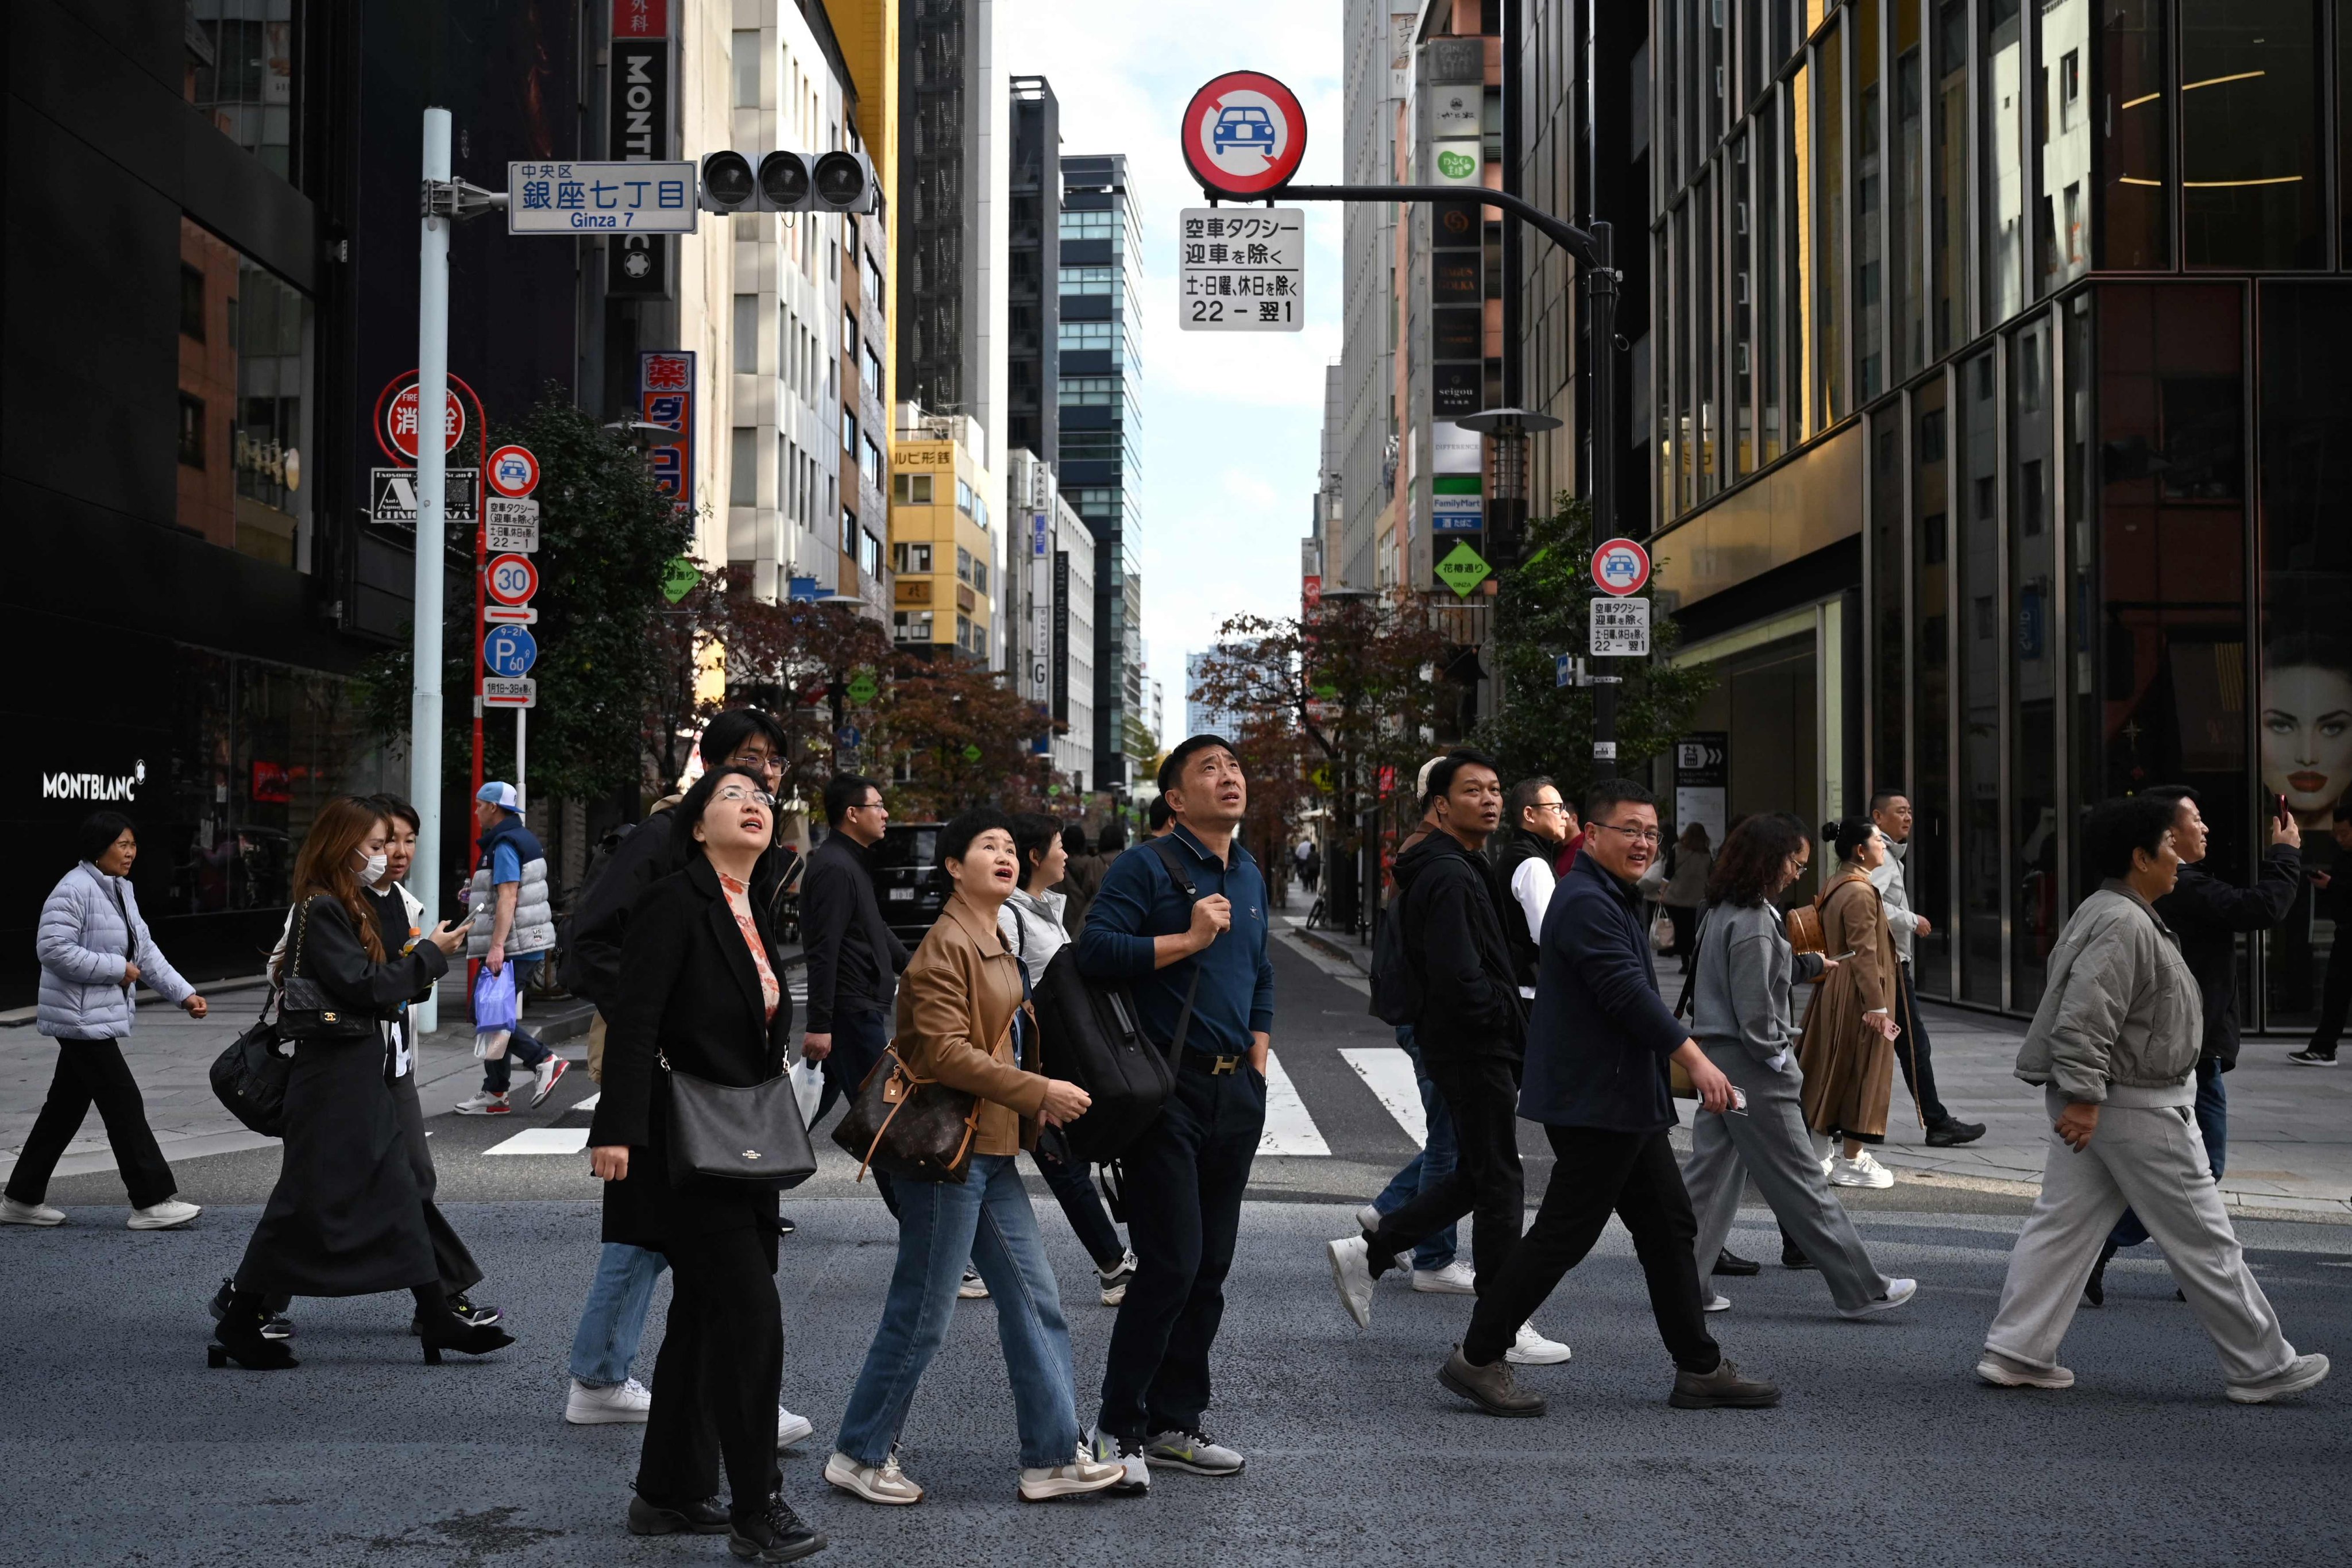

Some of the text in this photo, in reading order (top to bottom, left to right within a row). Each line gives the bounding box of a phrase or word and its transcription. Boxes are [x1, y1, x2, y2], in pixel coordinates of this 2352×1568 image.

[626, 56, 652, 249] MONTC
[522, 164, 573, 179] 中央区
[522, 180, 683, 210] 銀座七丁目
[570, 212, 634, 228] Ginza 7
[1185, 218, 1299, 239] 空車タクシー
[1185, 243, 1282, 264] 迎車を除く
[1185, 275, 1297, 296] 土・日曜、休日を除く
[643, 354, 689, 390] 薬
[403, 393, 418, 401] FIRE
[1439, 388, 1474, 397] seigou
[396, 407, 458, 435] 消栓
[650, 395, 685, 498] ダコク
[491, 503, 535, 513] 空車タクシー
[1434, 499, 1480, 508] FamilyMart
[1442, 519, 1473, 528] 酒 たばこ
[1056, 556, 1065, 592] HOTEL
[1443, 563, 1484, 573] 花椿通り
[498, 568, 527, 591] 30
[1056, 596, 1065, 635] MUSSE
[1595, 603, 1644, 614] 空車タクシー
[1595, 614, 1643, 625] 迎車を除く
[501, 628, 523, 636] 9-21
[496, 638, 516, 671] P
[1034, 663, 1045, 684] G
[43, 771, 136, 802] MONTBLANC
